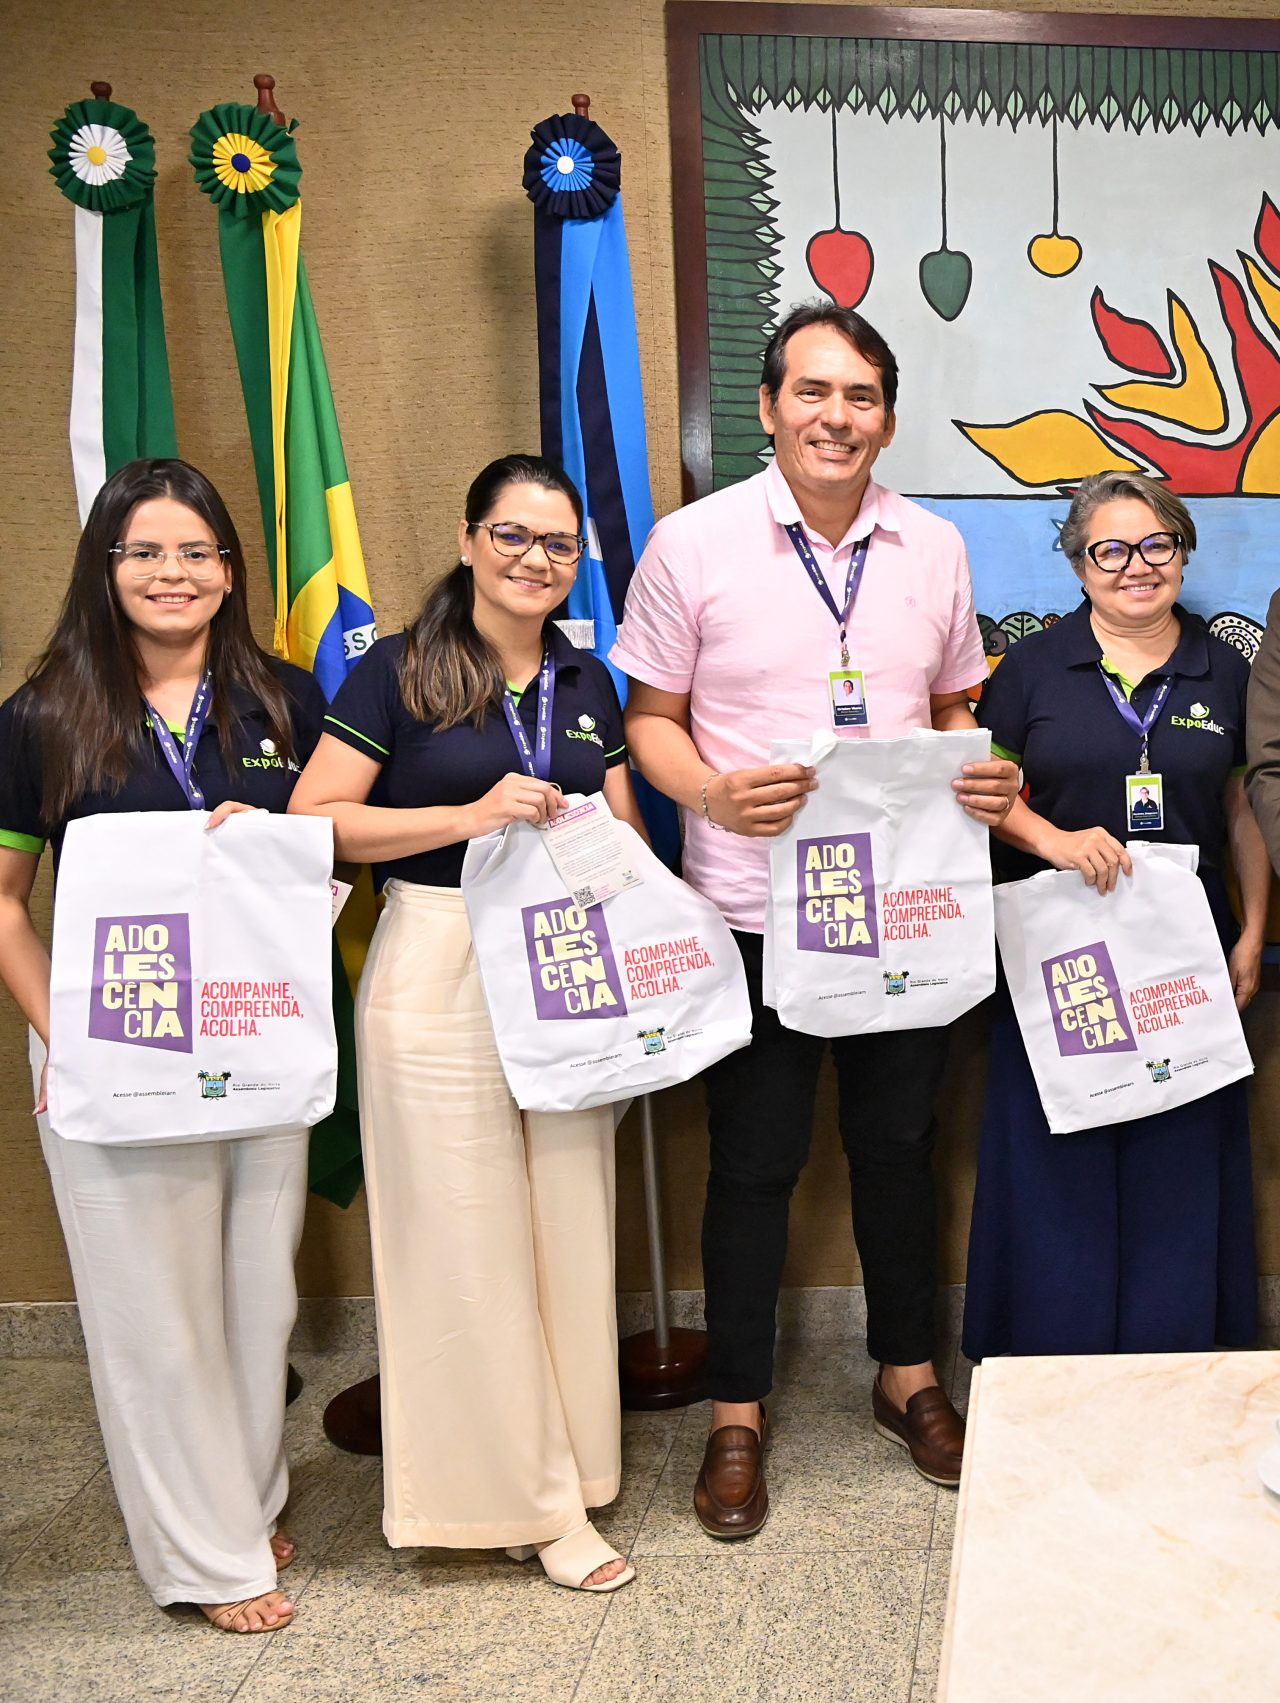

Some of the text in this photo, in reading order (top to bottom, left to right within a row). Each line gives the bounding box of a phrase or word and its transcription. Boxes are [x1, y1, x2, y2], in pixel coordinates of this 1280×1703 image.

[1171, 715, 1225, 735] ExpoEduc
[805, 843, 855, 870] ADO
[805, 869, 862, 897] LES
[806, 896, 865, 923] CÊN
[883, 887, 956, 908] ACOMPANHE,
[534, 905, 587, 938] ADO
[884, 903, 964, 925] COMPREENDA,
[105, 924, 168, 952] ADO
[825, 921, 872, 948] CIA
[884, 923, 931, 941] ACOLHA.
[535, 931, 598, 964] LES
[104, 953, 175, 980] LES
[541, 956, 606, 991] CÊN
[1051, 954, 1097, 987] ADO
[102, 982, 178, 1009] CÊN
[201, 982, 294, 1000] ACOMPANHE,
[564, 982, 618, 1014] CIA
[630, 976, 682, 1000] ACOLHA.
[1054, 976, 1108, 1010] LES
[201, 1001, 304, 1018] COMPREENDA,
[1061, 998, 1117, 1031] CÊN
[1137, 1012, 1183, 1034] ACOLHA.
[124, 1010, 184, 1038] CIA
[200, 1019, 261, 1036] ACOLHA.
[1082, 1020, 1128, 1049] CIA
